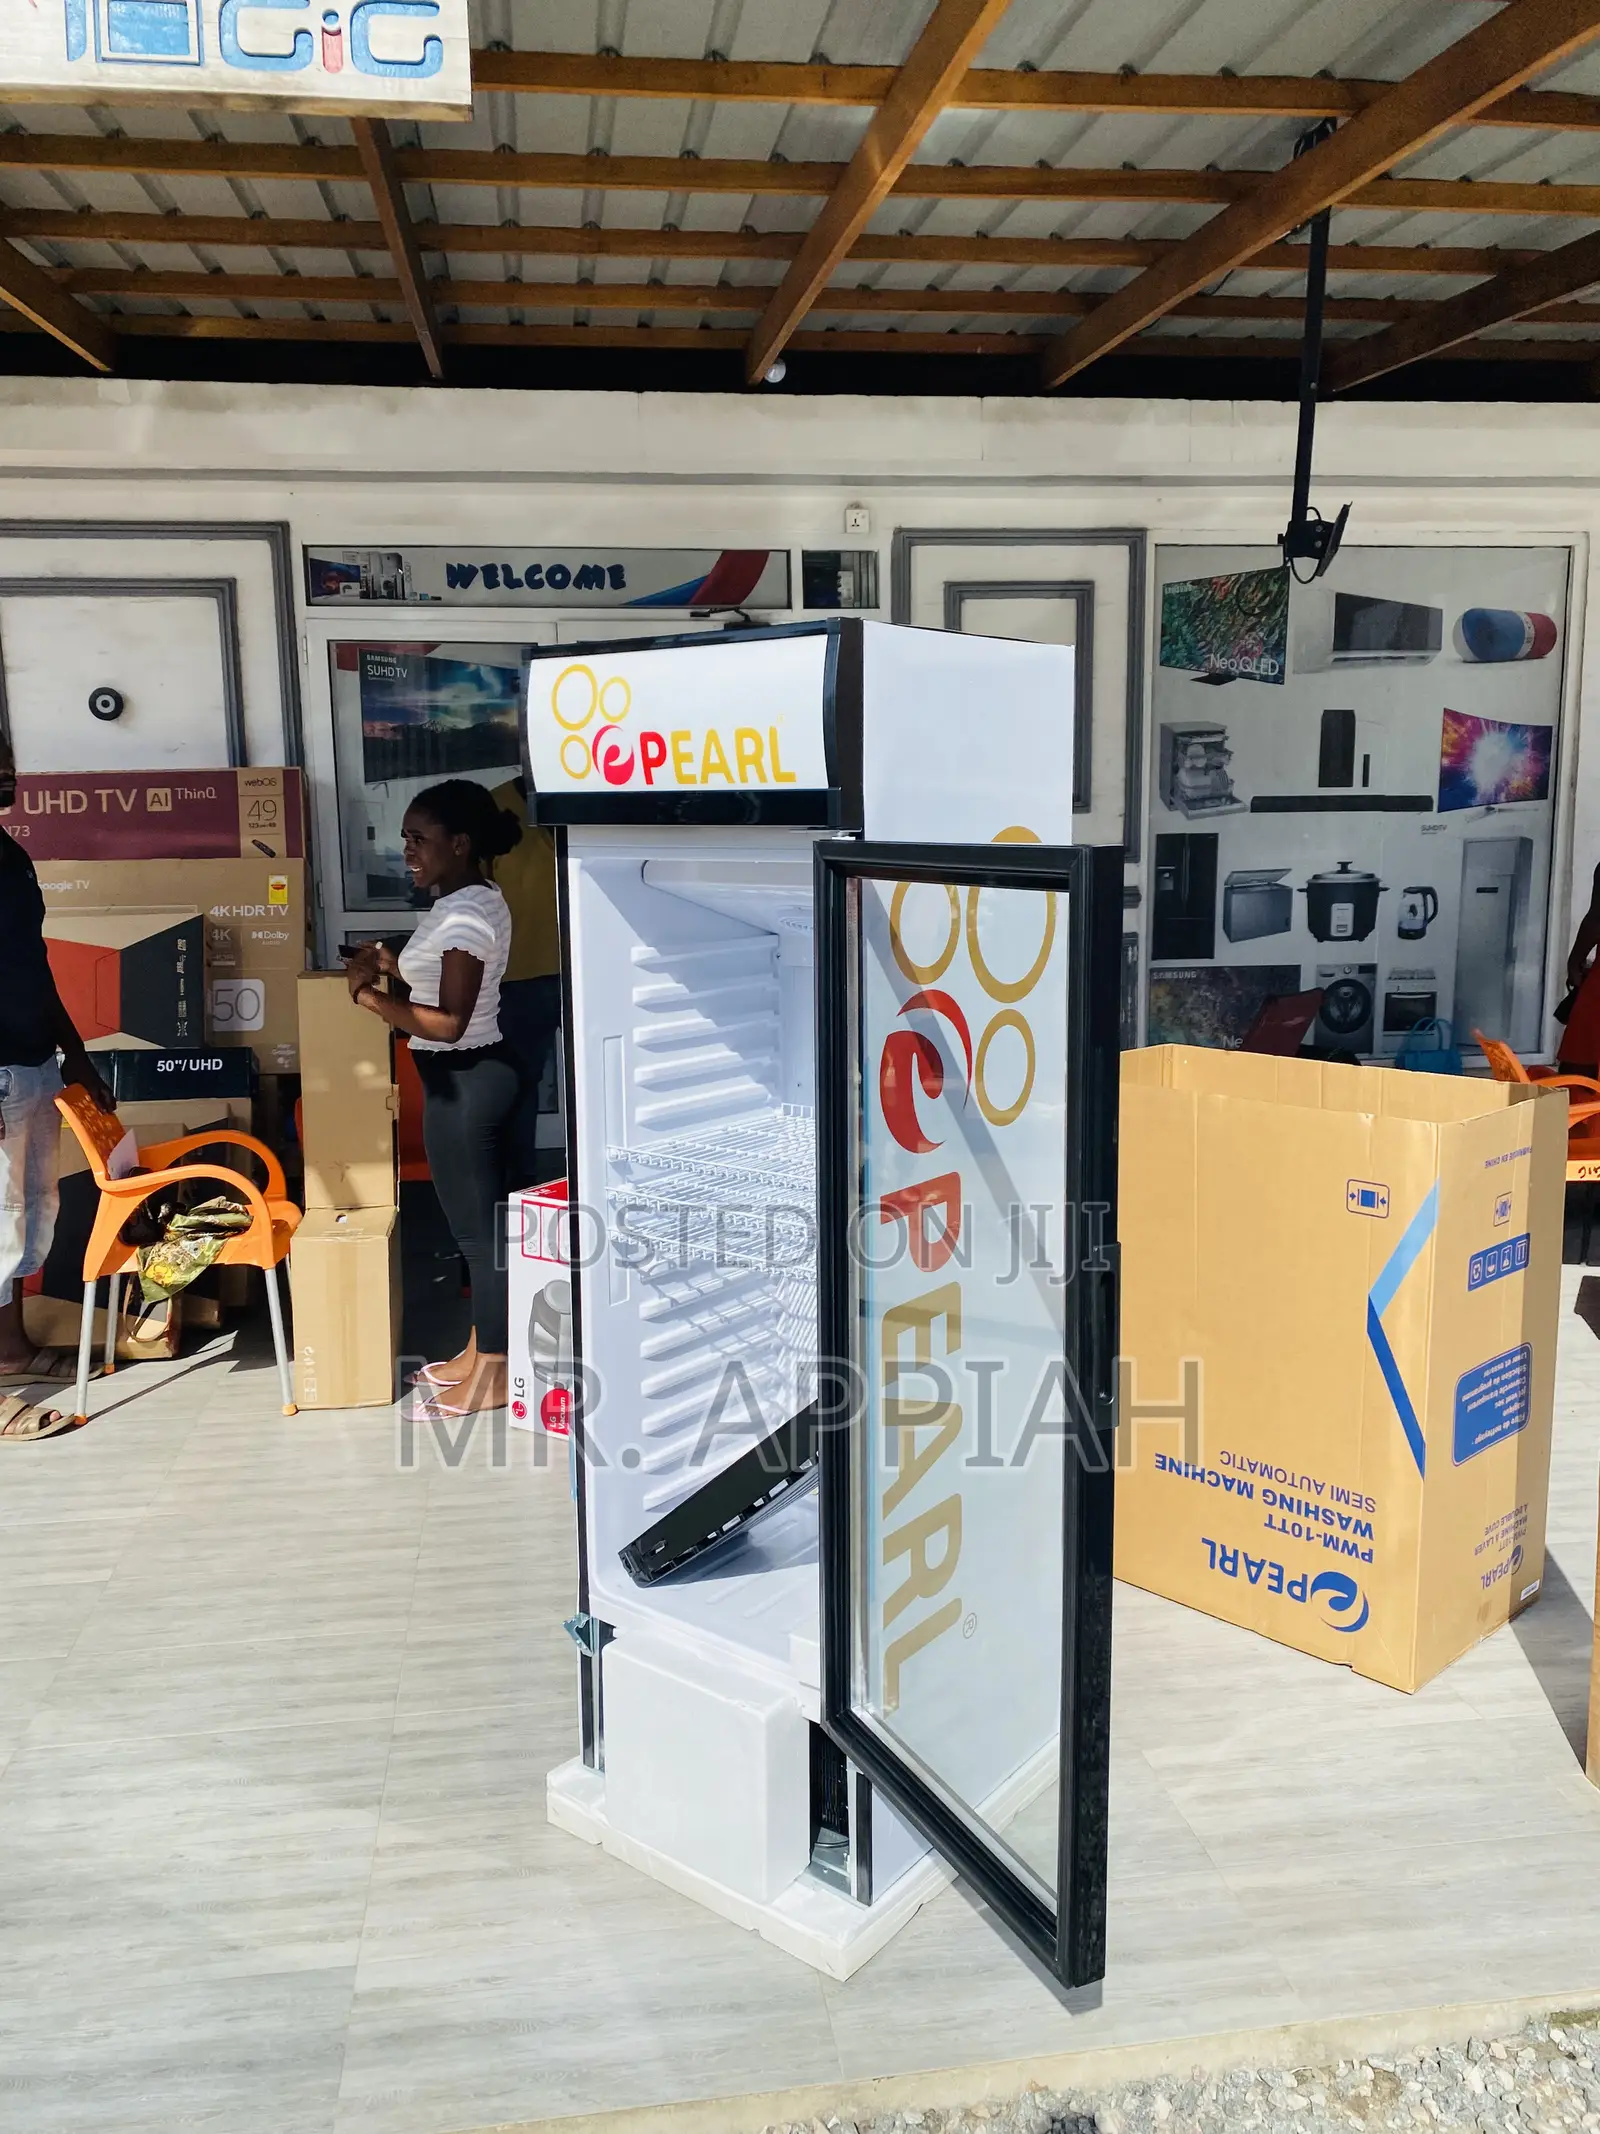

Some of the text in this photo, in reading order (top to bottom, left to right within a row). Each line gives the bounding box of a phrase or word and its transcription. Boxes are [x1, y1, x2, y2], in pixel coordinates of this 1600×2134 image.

[446, 563, 627, 590] WELCOME
[367, 664, 408, 678] SUHD TV
[1209, 654, 1279, 676] Neo QLED
[639, 726, 797, 785] PEARL
[244, 777, 277, 787] webOS
[23, 790, 88, 815] UHD
[95, 789, 137, 812] TV
[150, 793, 169, 808] AI
[175, 787, 216, 800] ThinQ
[247, 799, 277, 821] 49
[76, 880, 90, 890] TV
[209, 904, 289, 917] 4K HDR TV
[211, 928, 232, 941] 4K
[264, 930, 290, 940] Dolby
[1153, 970, 1198, 980] SAMSUNG
[212, 987, 260, 1021] 50
[1222, 1034, 1244, 1049] Ne
[514, 1377, 525, 1398] LG
[558, 1396, 566, 1430] Vacuum
[880, 1171, 963, 1720] PEARL
[1219, 1450, 1376, 1514] SEMI AUTOMATIC
[1155, 1452, 1375, 1541] WASHING MACHINE
[1263, 1513, 1374, 1564] PWM-10TT
[1201, 1537, 1309, 1603] PEARL
[1480, 1558, 1511, 1590] PEARL
